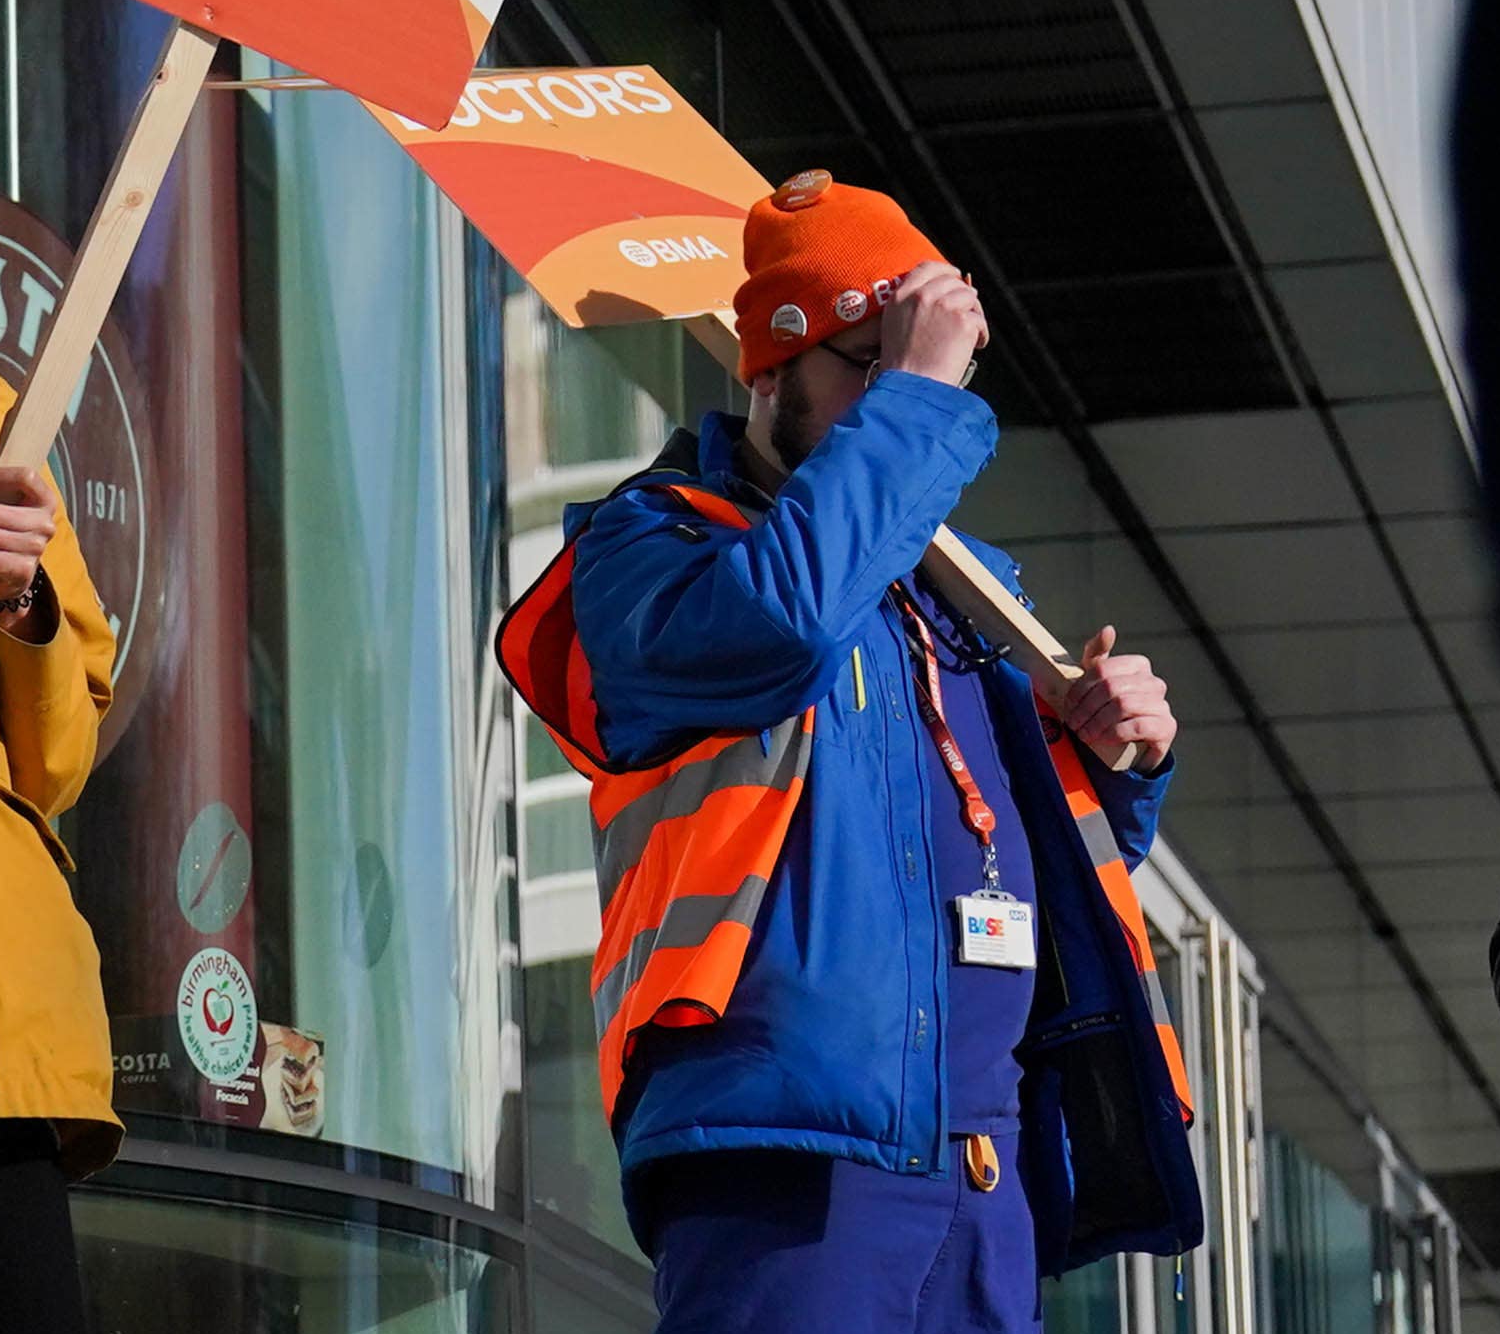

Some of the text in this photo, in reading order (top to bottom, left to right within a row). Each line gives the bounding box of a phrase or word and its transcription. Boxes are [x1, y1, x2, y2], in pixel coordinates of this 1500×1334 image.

[395, 70, 673, 131] OCTORS
[646, 235, 729, 263] BMA
[85, 478, 127, 525] 1971
[968, 916, 1005, 936] BASE
[181, 953, 248, 1008] birmingham
